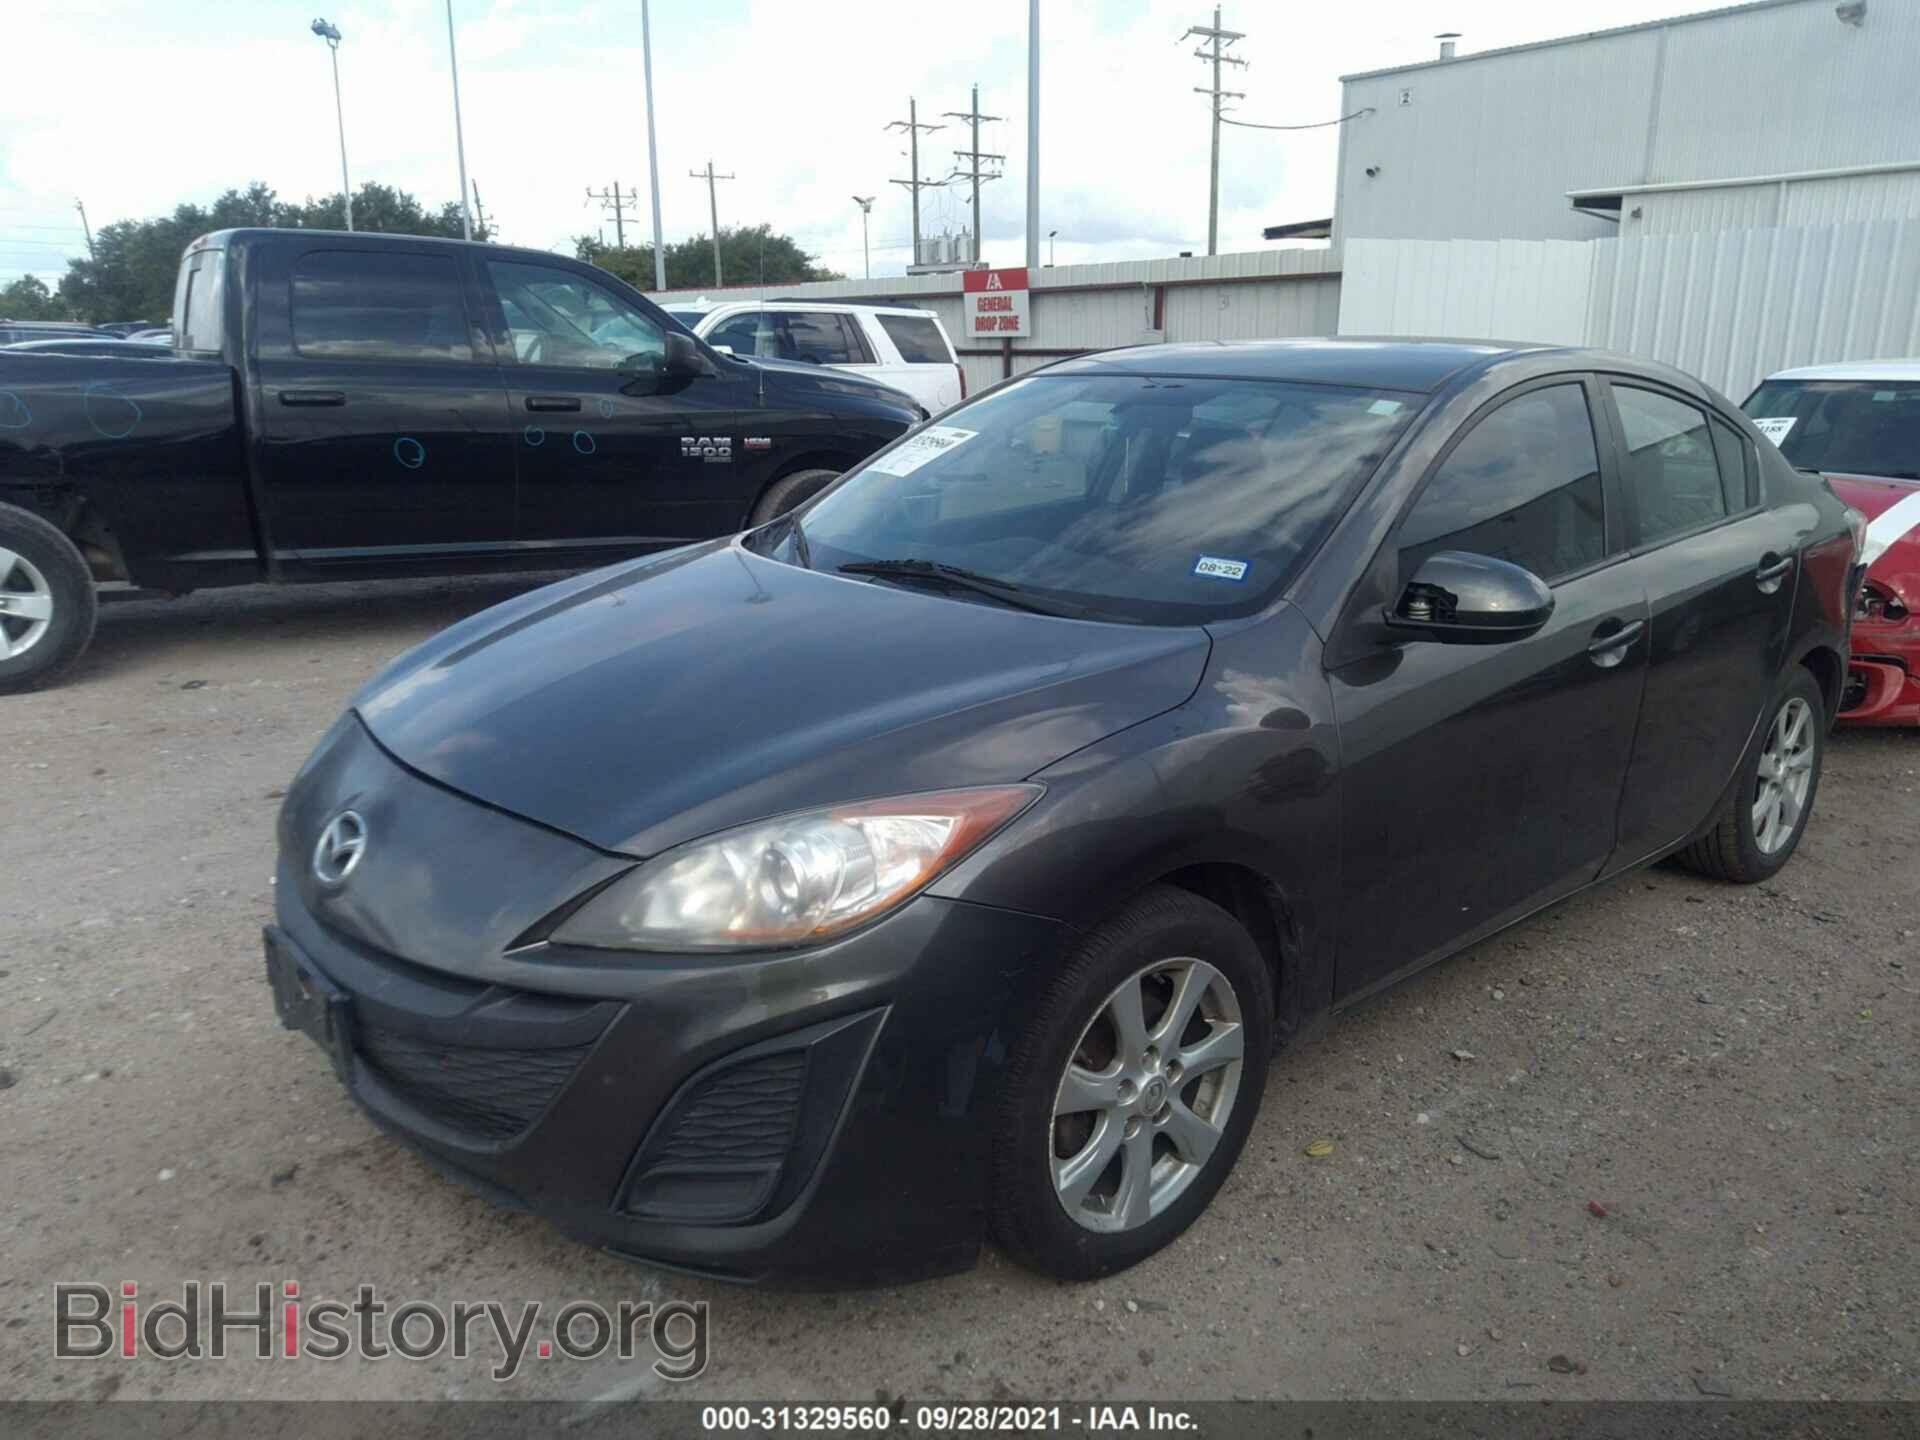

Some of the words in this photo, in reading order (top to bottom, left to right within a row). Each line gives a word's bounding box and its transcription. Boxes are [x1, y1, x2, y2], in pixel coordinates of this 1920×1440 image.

[977, 296, 1013, 312] GENERAL
[975, 316, 997, 331] DROP
[998, 315, 1019, 331] ZONE
[681, 437, 732, 446] RAM
[681, 447, 732, 456] 1500
